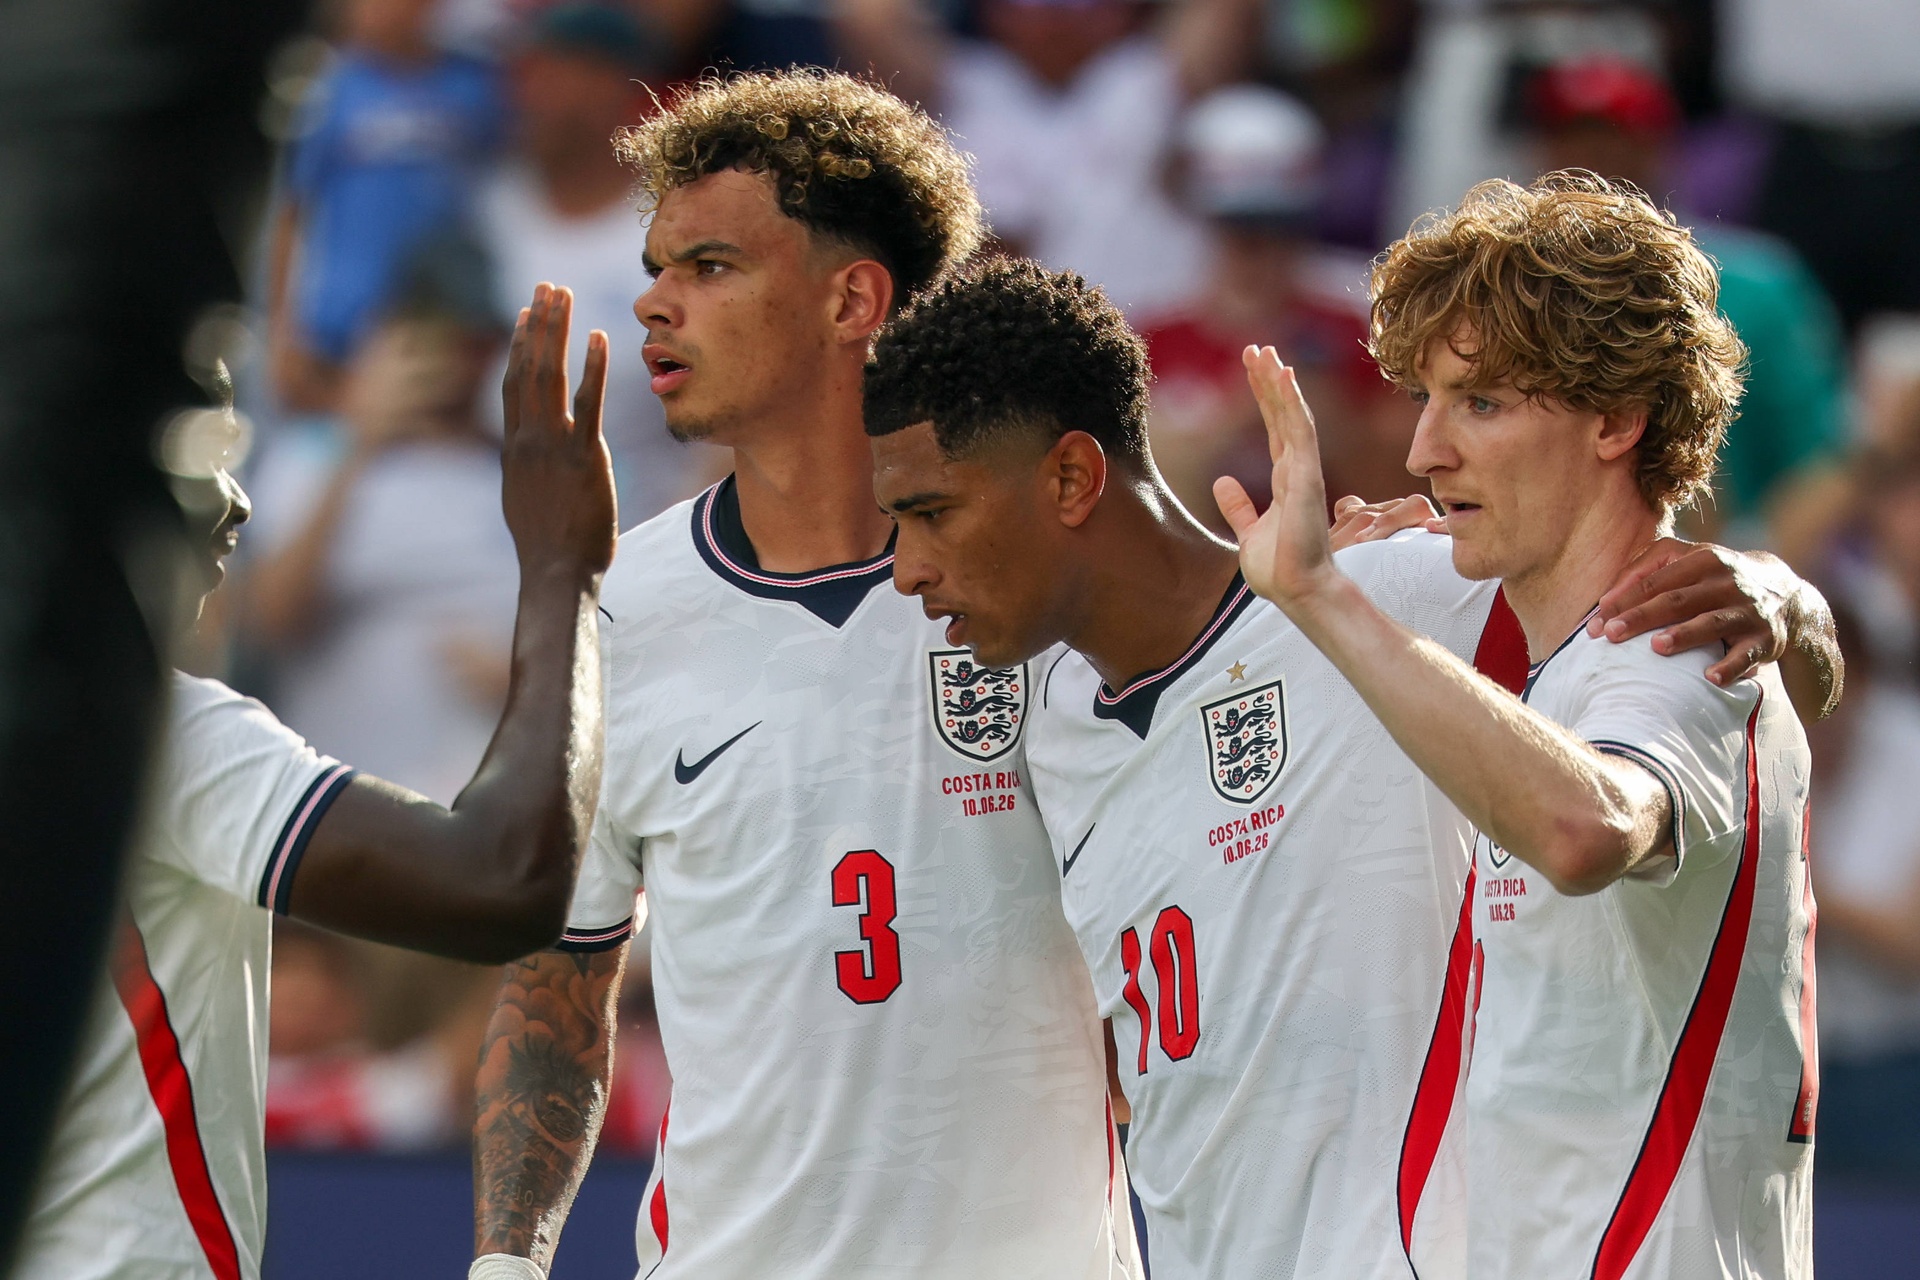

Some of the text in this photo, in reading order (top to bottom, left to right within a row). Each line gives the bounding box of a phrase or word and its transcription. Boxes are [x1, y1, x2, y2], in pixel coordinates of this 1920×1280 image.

[942, 773, 992, 795] COSTA
[962, 794, 1015, 817] 10.06.26
[1208, 804, 1285, 847] COSTA RICA
[1223, 832, 1269, 865] 10.06.26
[1503, 878, 1527, 897] RICA
[831, 849, 902, 1005] 3
[1121, 904, 1201, 1077] 10
